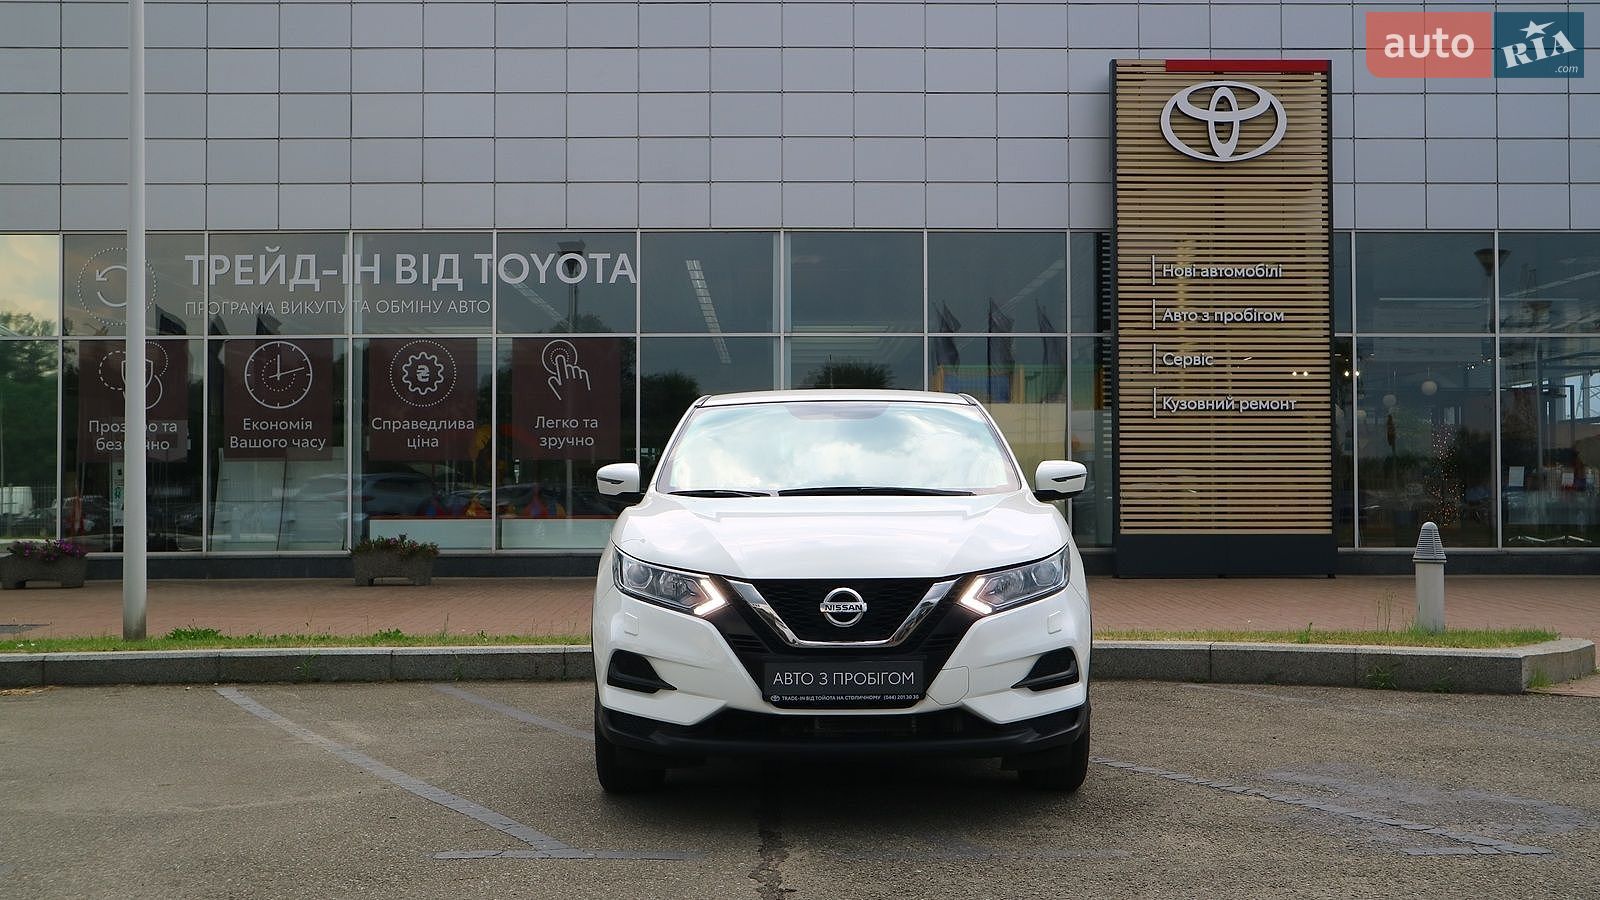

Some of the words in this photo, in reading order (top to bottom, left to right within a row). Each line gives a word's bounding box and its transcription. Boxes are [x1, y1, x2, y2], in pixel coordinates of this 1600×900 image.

[184, 245, 381, 292] ТРЕЙД-ІН
[395, 253, 464, 292] ВІД
[474, 253, 637, 284] TOYOTA
[1162, 264, 1197, 278] Нові
[1200, 263, 1283, 278] автомобілі
[185, 301, 275, 315] ПРОГРАМА
[281, 300, 347, 314] ВИКУПУ
[352, 300, 371, 313] ТА
[376, 300, 443, 314] ОБМІНУ
[447, 300, 491, 314] АВТО
[1162, 308, 1198, 322] Авто
[1201, 310, 1211, 322] з
[1214, 307, 1285, 325] пробігом
[1162, 352, 1215, 369] Сервіс
[1162, 395, 1235, 413] Кузовний
[1239, 399, 1297, 413] ремонт
[89, 420, 158, 436] Прозо
[162, 422, 178, 433] та
[243, 417, 313, 431] Економія
[371, 417, 475, 433] Справедлива
[534, 416, 579, 429] Легко
[582, 417, 599, 429] та
[230, 436, 288, 449] Вашого
[292, 437, 327, 451] часу
[407, 434, 439, 449] ціна
[539, 435, 595, 449] зручно
[772, 671, 815, 686] АВТО
[818, 671, 829, 686] З
[833, 671, 915, 686] ПРОБІГОМ
